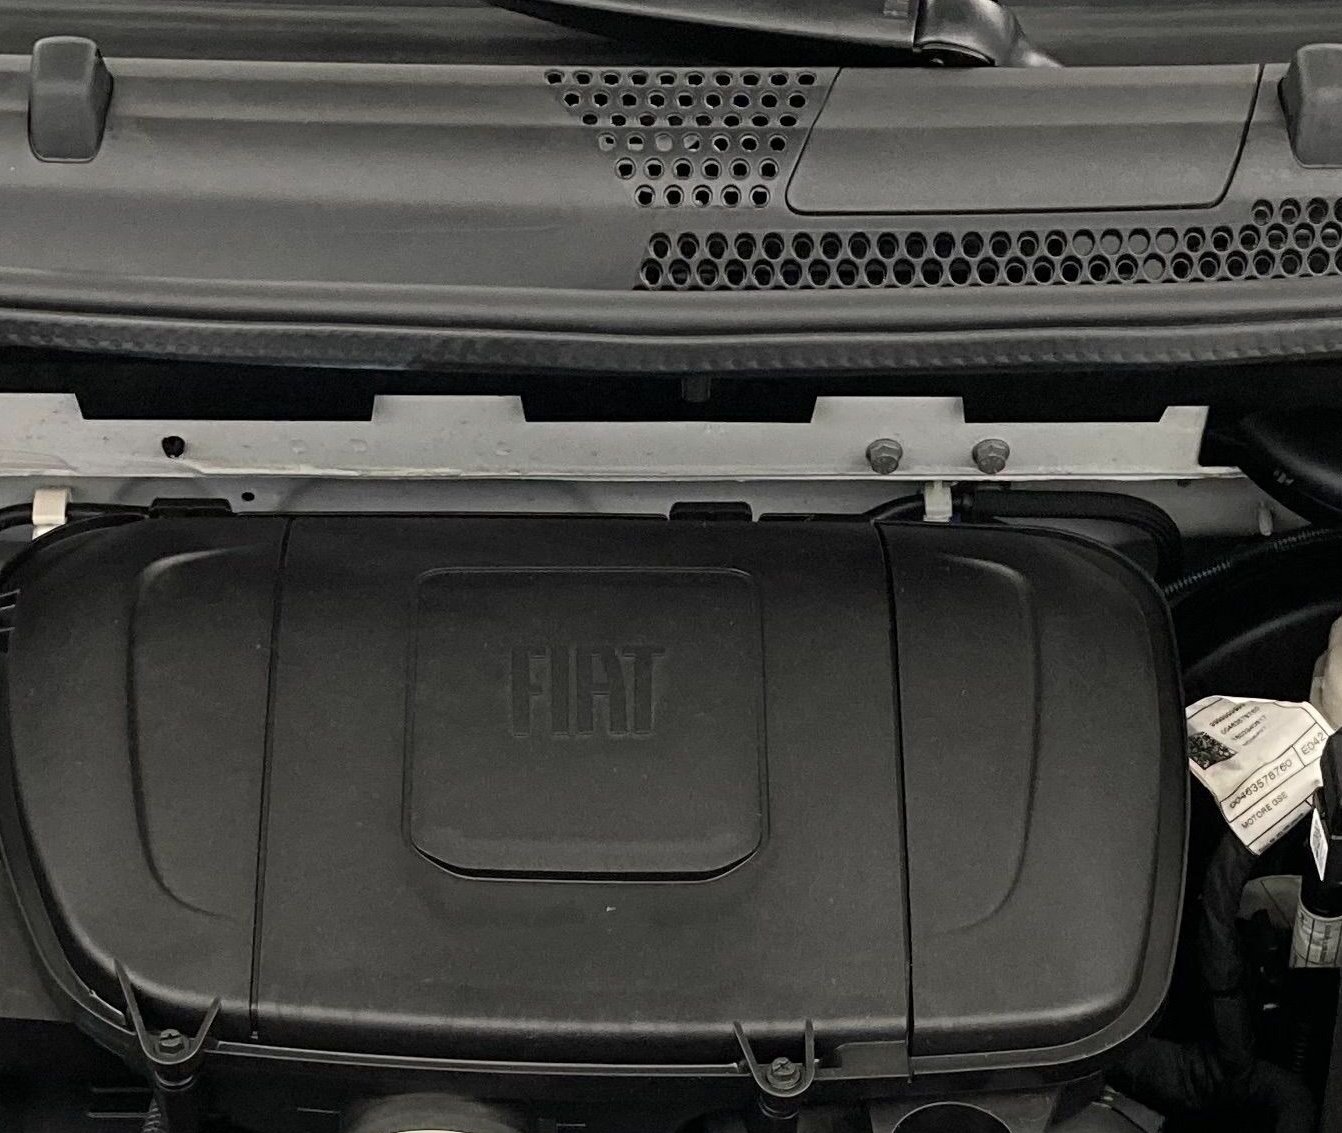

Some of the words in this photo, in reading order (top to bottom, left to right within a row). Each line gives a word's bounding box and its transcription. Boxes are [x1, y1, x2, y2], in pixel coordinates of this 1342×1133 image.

[510, 648, 667, 738] FIAT
[1301, 731, 1326, 756] E042
[1240, 804, 1273, 829] MOTORE
